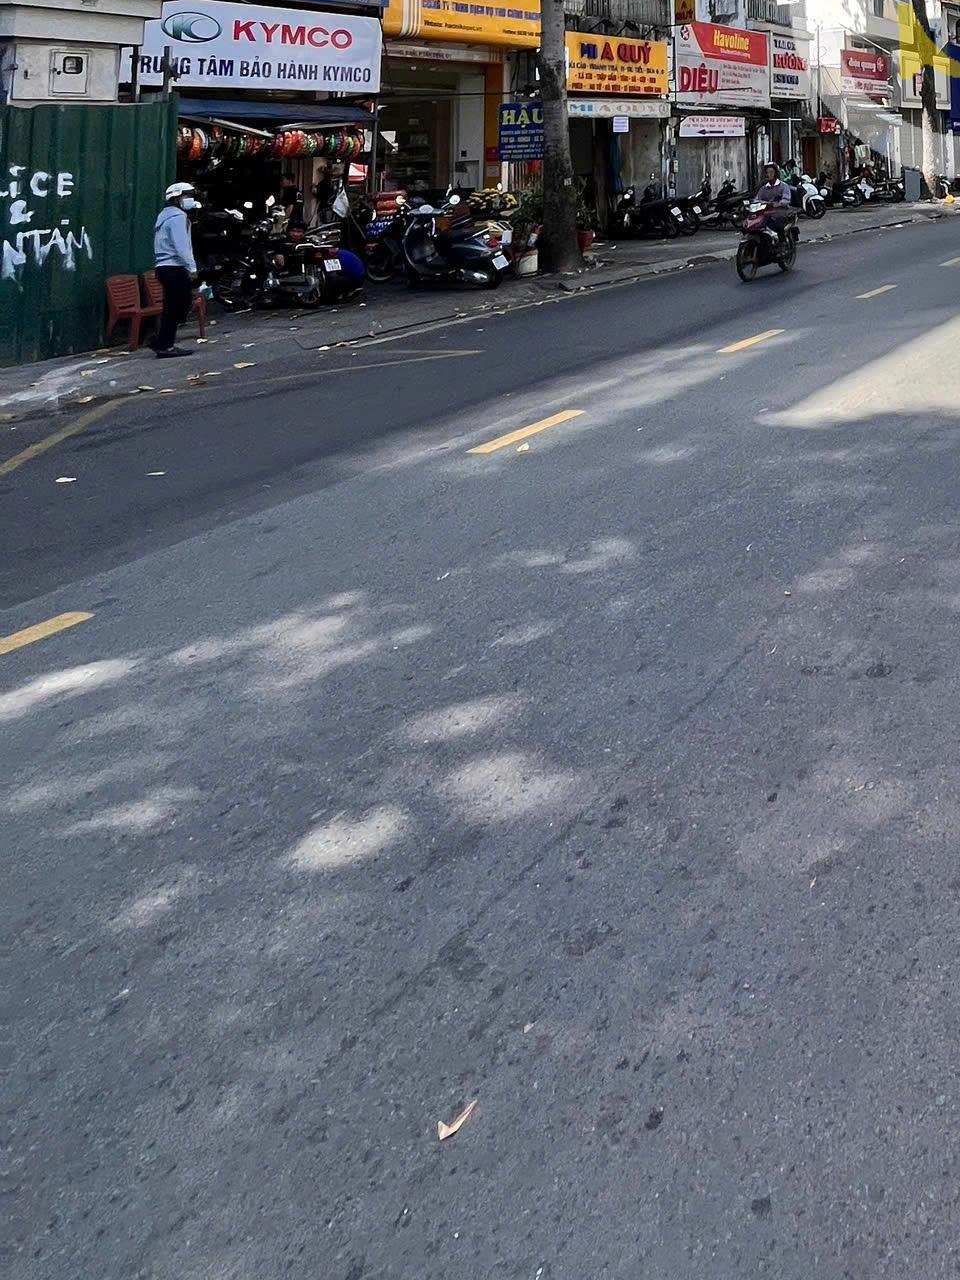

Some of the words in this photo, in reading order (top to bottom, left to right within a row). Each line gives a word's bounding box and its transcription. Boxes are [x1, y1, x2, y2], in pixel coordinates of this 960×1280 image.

[232, 19, 353, 50] KYMCO
[713, 29, 750, 51] Havoline
[600, 41, 615, 61] A
[197, 55, 234, 78] TÂM
[239, 56, 272, 79] BẢO
[277, 59, 319, 82] HÀNH
[323, 65, 371, 83] KYMCO
[679, 62, 719, 99] DIỆU
[502, 104, 544, 128] HẬU
